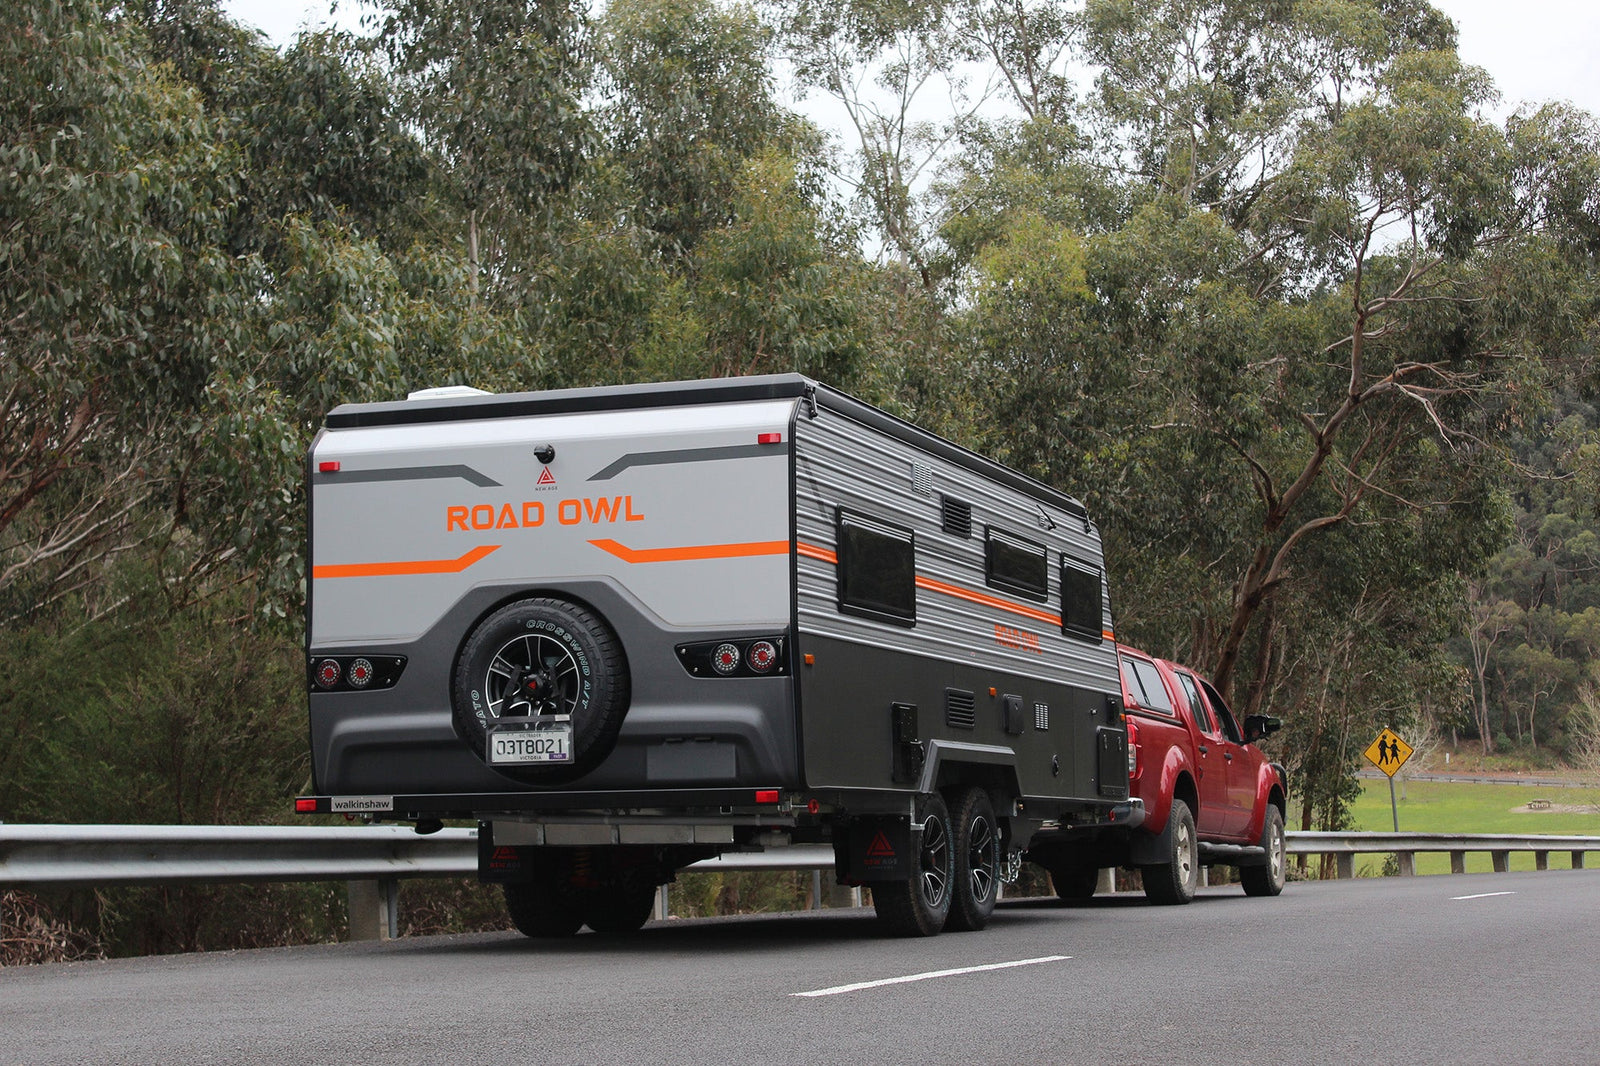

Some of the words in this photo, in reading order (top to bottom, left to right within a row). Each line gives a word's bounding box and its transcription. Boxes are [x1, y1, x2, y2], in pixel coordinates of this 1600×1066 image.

[447, 502, 545, 532] ROAD
[558, 495, 645, 526] OWL
[994, 624, 1020, 650] ROAD
[1021, 631, 1043, 655] OWL
[526, 620, 591, 676] CROSSWIND
[581, 680, 591, 710] A/T
[497, 738, 562, 755] 03T8021
[335, 800, 389, 809] walkinshaw
